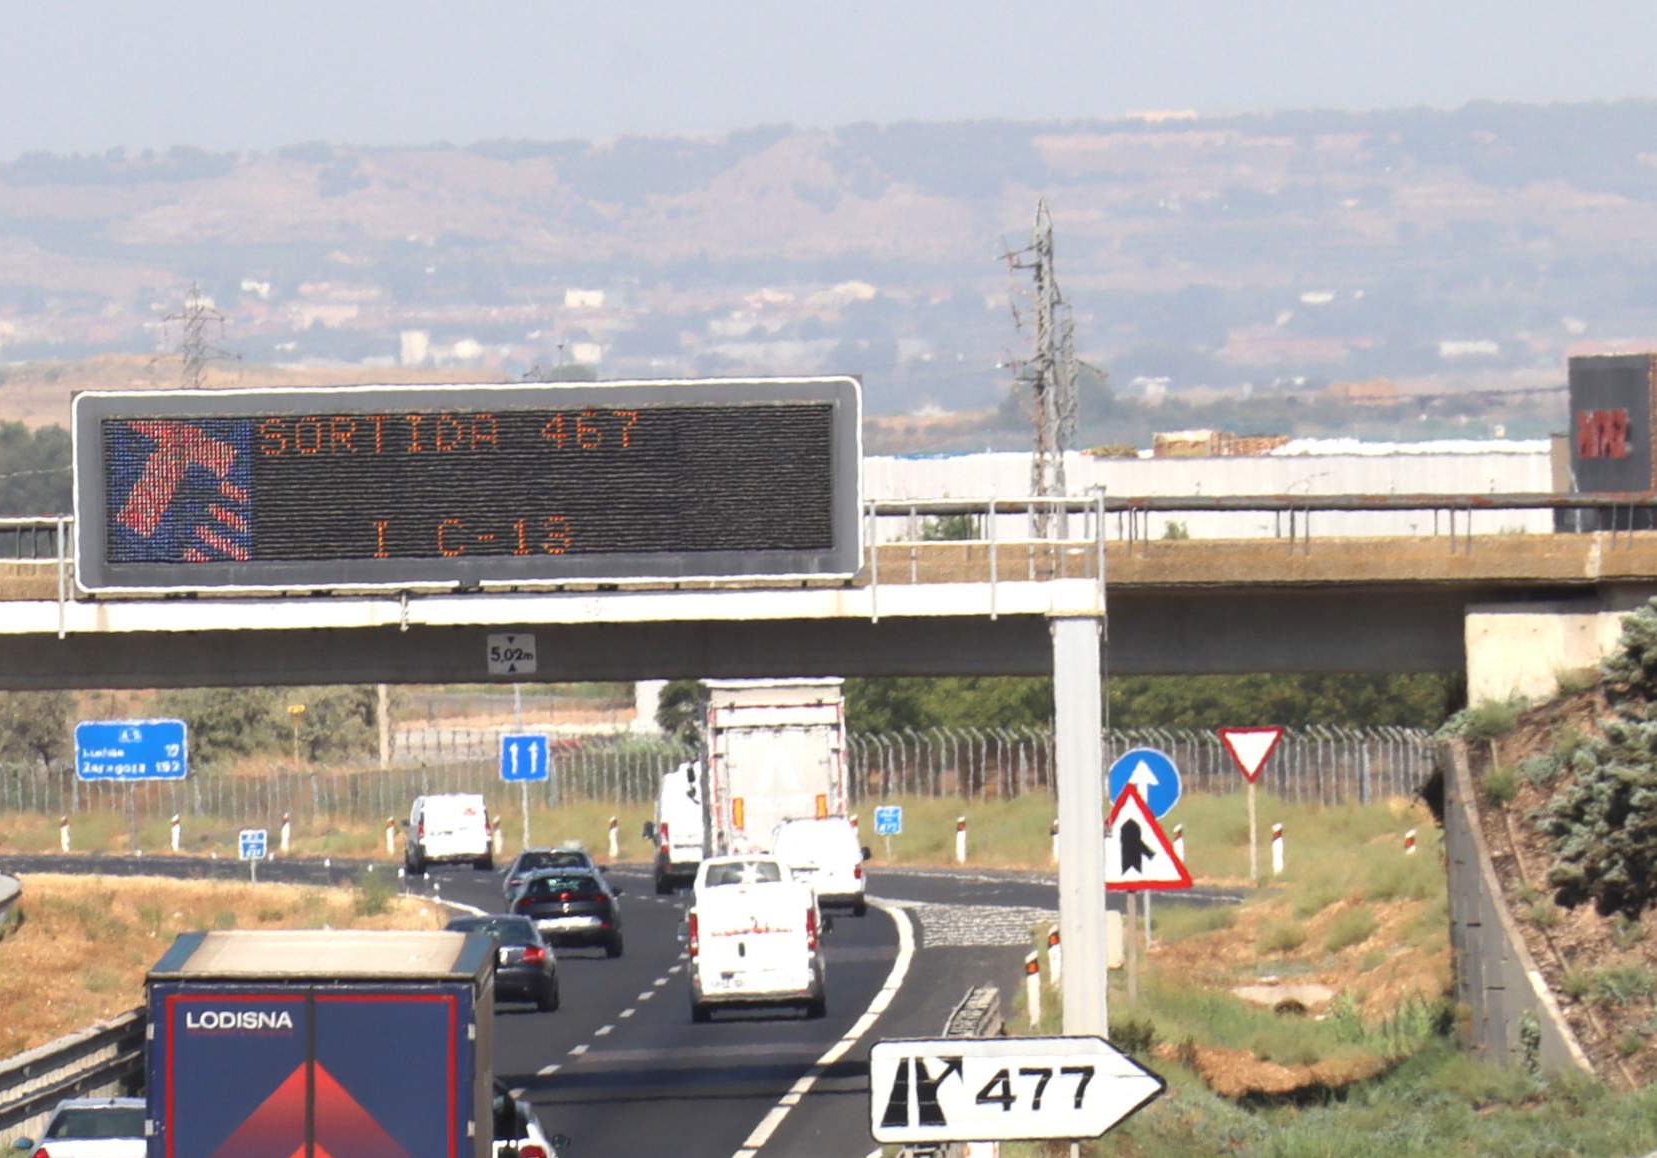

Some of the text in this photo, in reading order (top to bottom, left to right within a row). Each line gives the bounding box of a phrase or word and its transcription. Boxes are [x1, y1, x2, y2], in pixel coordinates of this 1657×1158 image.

[259, 410, 639, 455] SORTIDA 467
[438, 516, 573, 556] C-13
[186, 1010, 293, 1029] LODISNA
[975, 1065, 1095, 1111] 477
